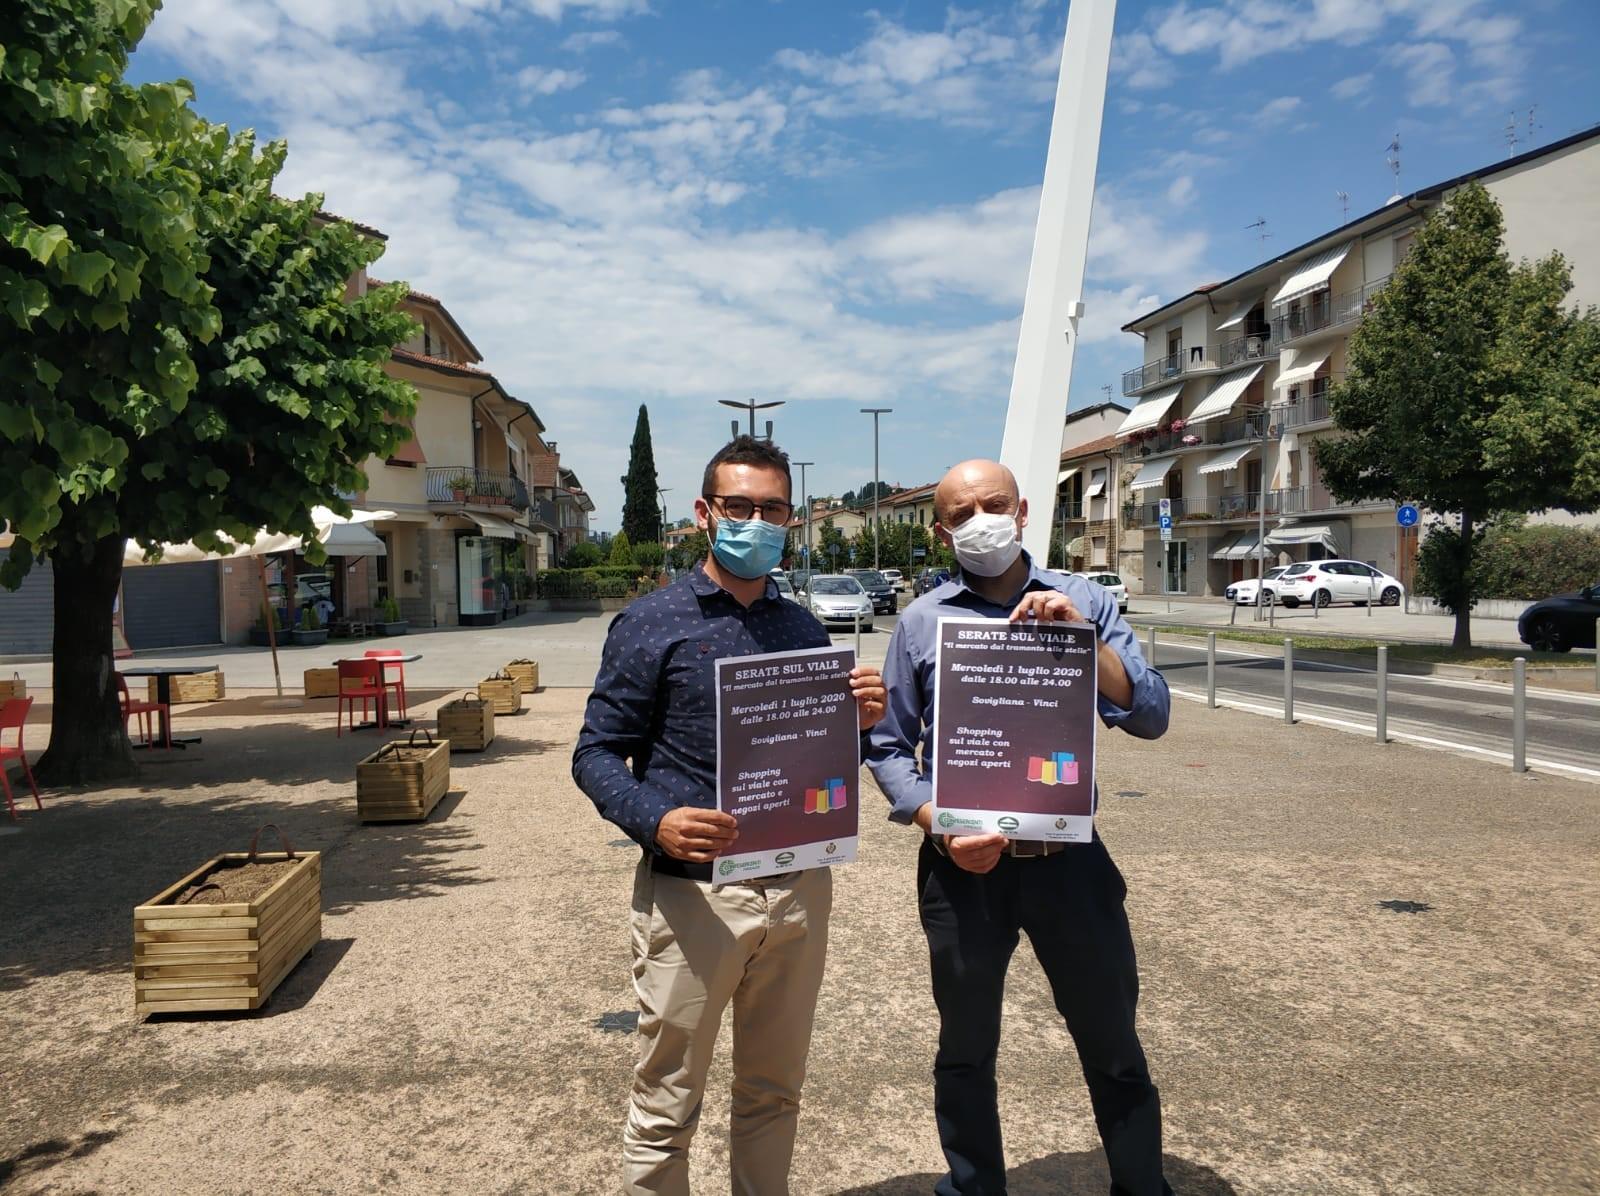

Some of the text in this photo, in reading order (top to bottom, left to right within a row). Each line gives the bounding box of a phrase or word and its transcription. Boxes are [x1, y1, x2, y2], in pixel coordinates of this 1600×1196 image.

[1162, 518, 1169, 528] P
[958, 631, 1076, 643] SERATE SUL VIALE
[1006, 644, 1045, 652] tramonto
[736, 660, 839, 680] SERATE SUL VIALE
[1018, 666, 1050, 676] luglio
[1053, 668, 1082, 677] 2020
[734, 682, 763, 691] mercato
[766, 679, 777, 687] dal
[779, 676, 813, 685] tramonto
[815, 673, 828, 681] alle
[961, 675, 986, 683] dalle
[990, 677, 1018, 685] 18.00
[1042, 679, 1071, 687] 24.00
[782, 700, 786, 708] 1
[791, 698, 818, 709] luglio
[821, 693, 846, 703] 2020
[972, 696, 1024, 707] Sovigliana
[1034, 699, 1058, 708] Vinci
[741, 706, 836, 725] dalle 18.00 alle 24.00
[751, 733, 798, 745] Sovigliana
[806, 728, 827, 738] Vinci
[957, 727, 1003, 738] Shopping
[949, 738, 964, 746] sul
[967, 739, 990, 747] viale
[956, 749, 995, 757] mercato
[948, 758, 1011, 769] negozi aperti
[738, 768, 781, 781] Shopping
[732, 778, 788, 793] sul viale con
[738, 791, 775, 803] mercato
[731, 798, 790, 816] negozi aperti
